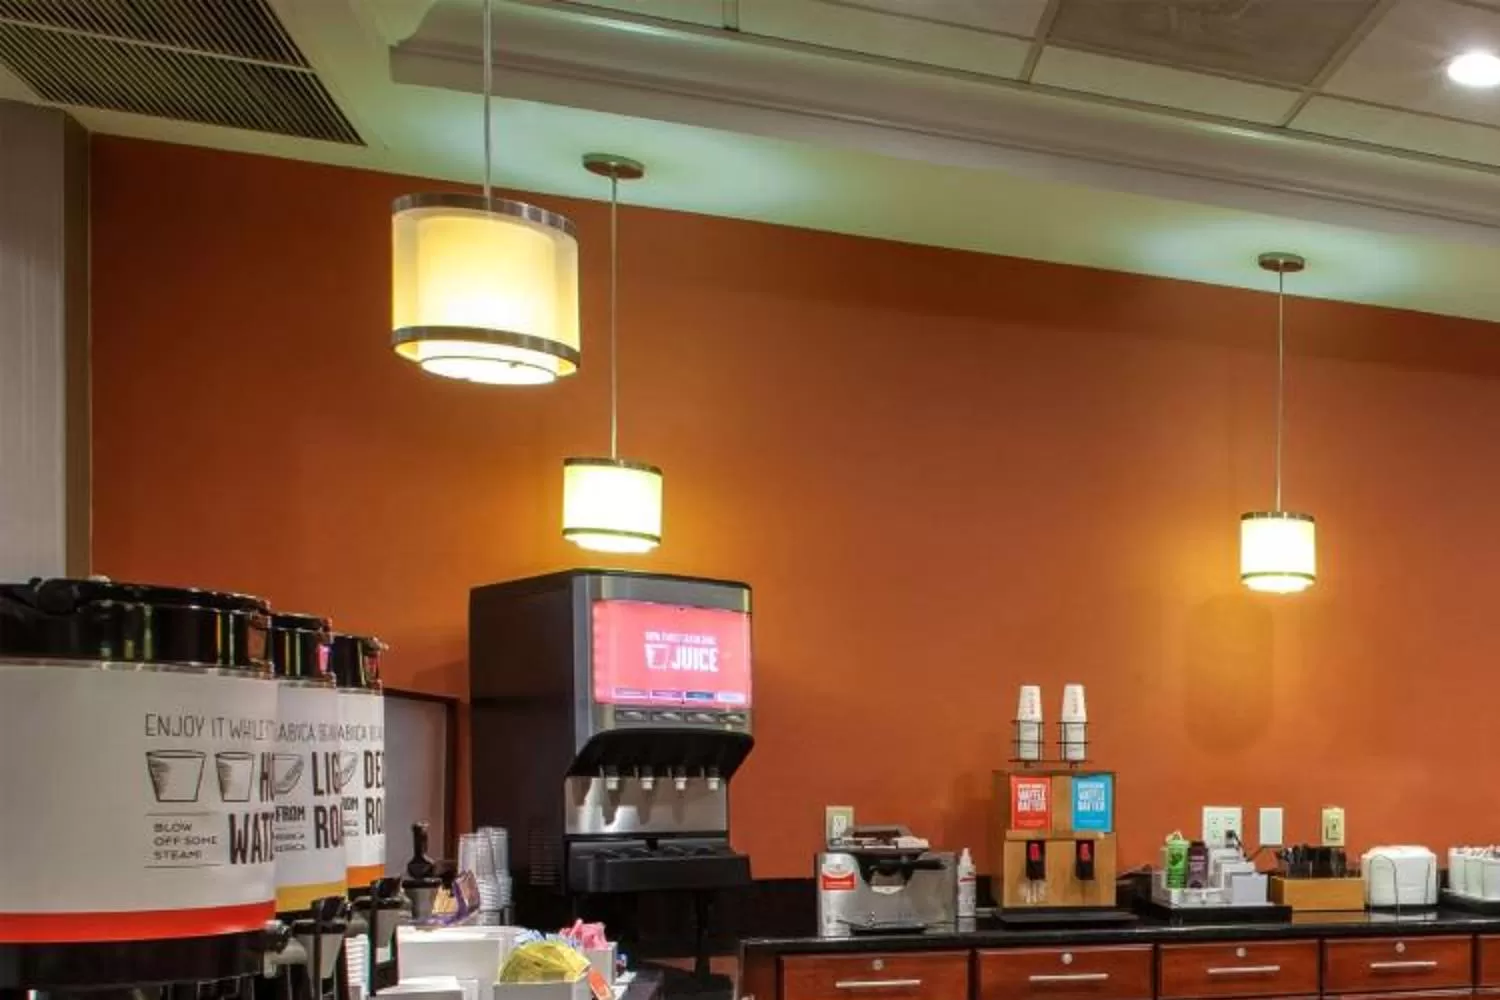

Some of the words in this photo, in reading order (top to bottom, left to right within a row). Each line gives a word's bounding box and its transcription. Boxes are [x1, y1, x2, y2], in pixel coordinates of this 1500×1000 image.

[671, 646, 719, 672] JUICE
[145, 713, 204, 737] ENJOY
[211, 718, 224, 738] IT
[153, 822, 193, 833] BLOW
[153, 836, 181, 846] OFF
[184, 836, 218, 846] SOME
